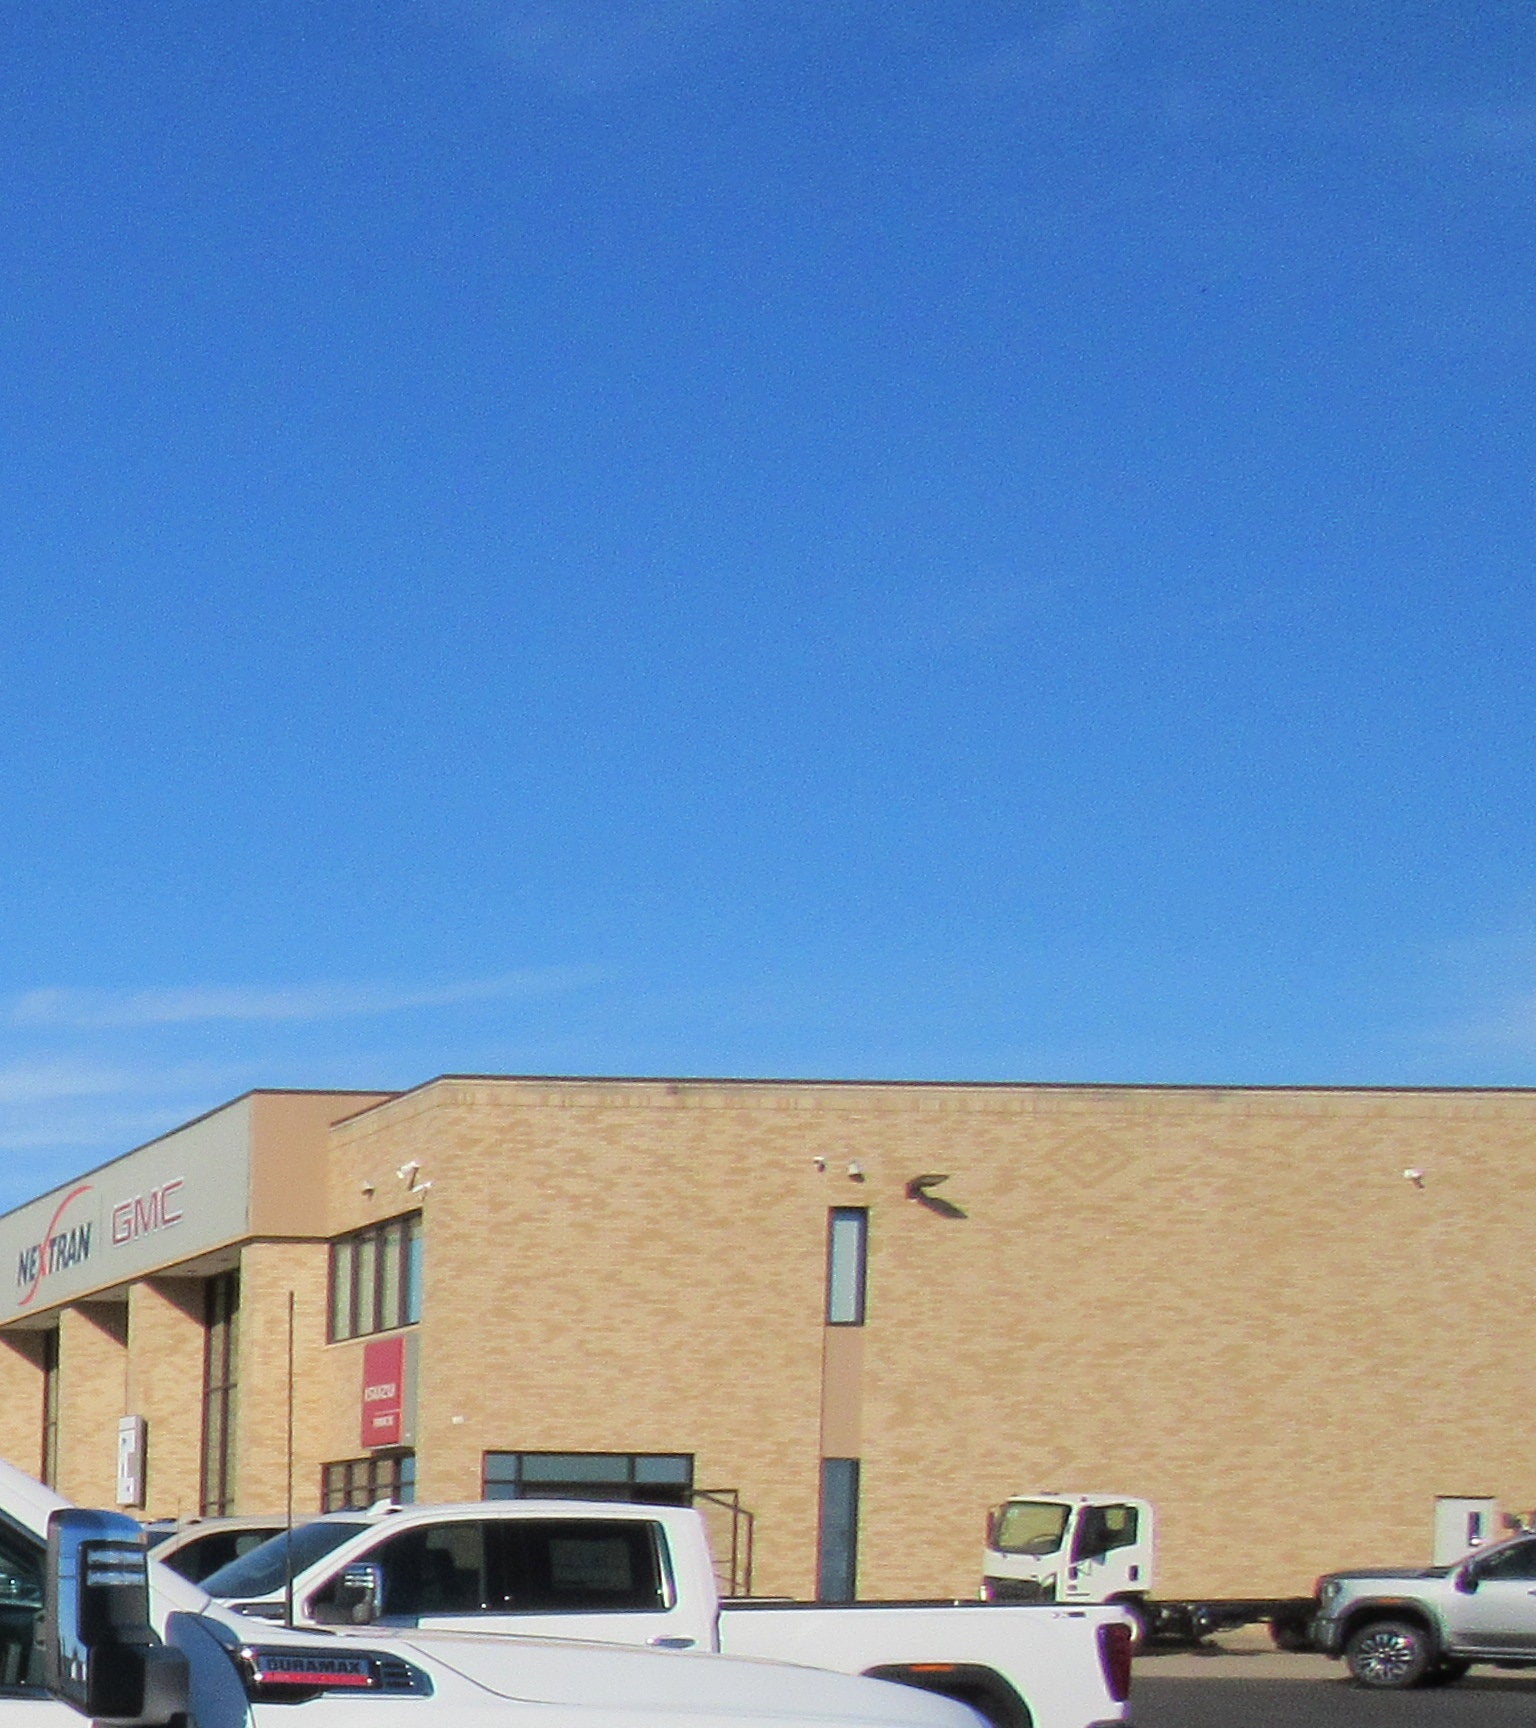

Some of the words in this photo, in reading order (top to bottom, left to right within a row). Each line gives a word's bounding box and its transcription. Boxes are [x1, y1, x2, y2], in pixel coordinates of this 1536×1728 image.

[112, 1176, 184, 1247] GMC
[17, 1213, 95, 1292] NEXTRAN
[269, 1659, 360, 1673] DURAMAX
